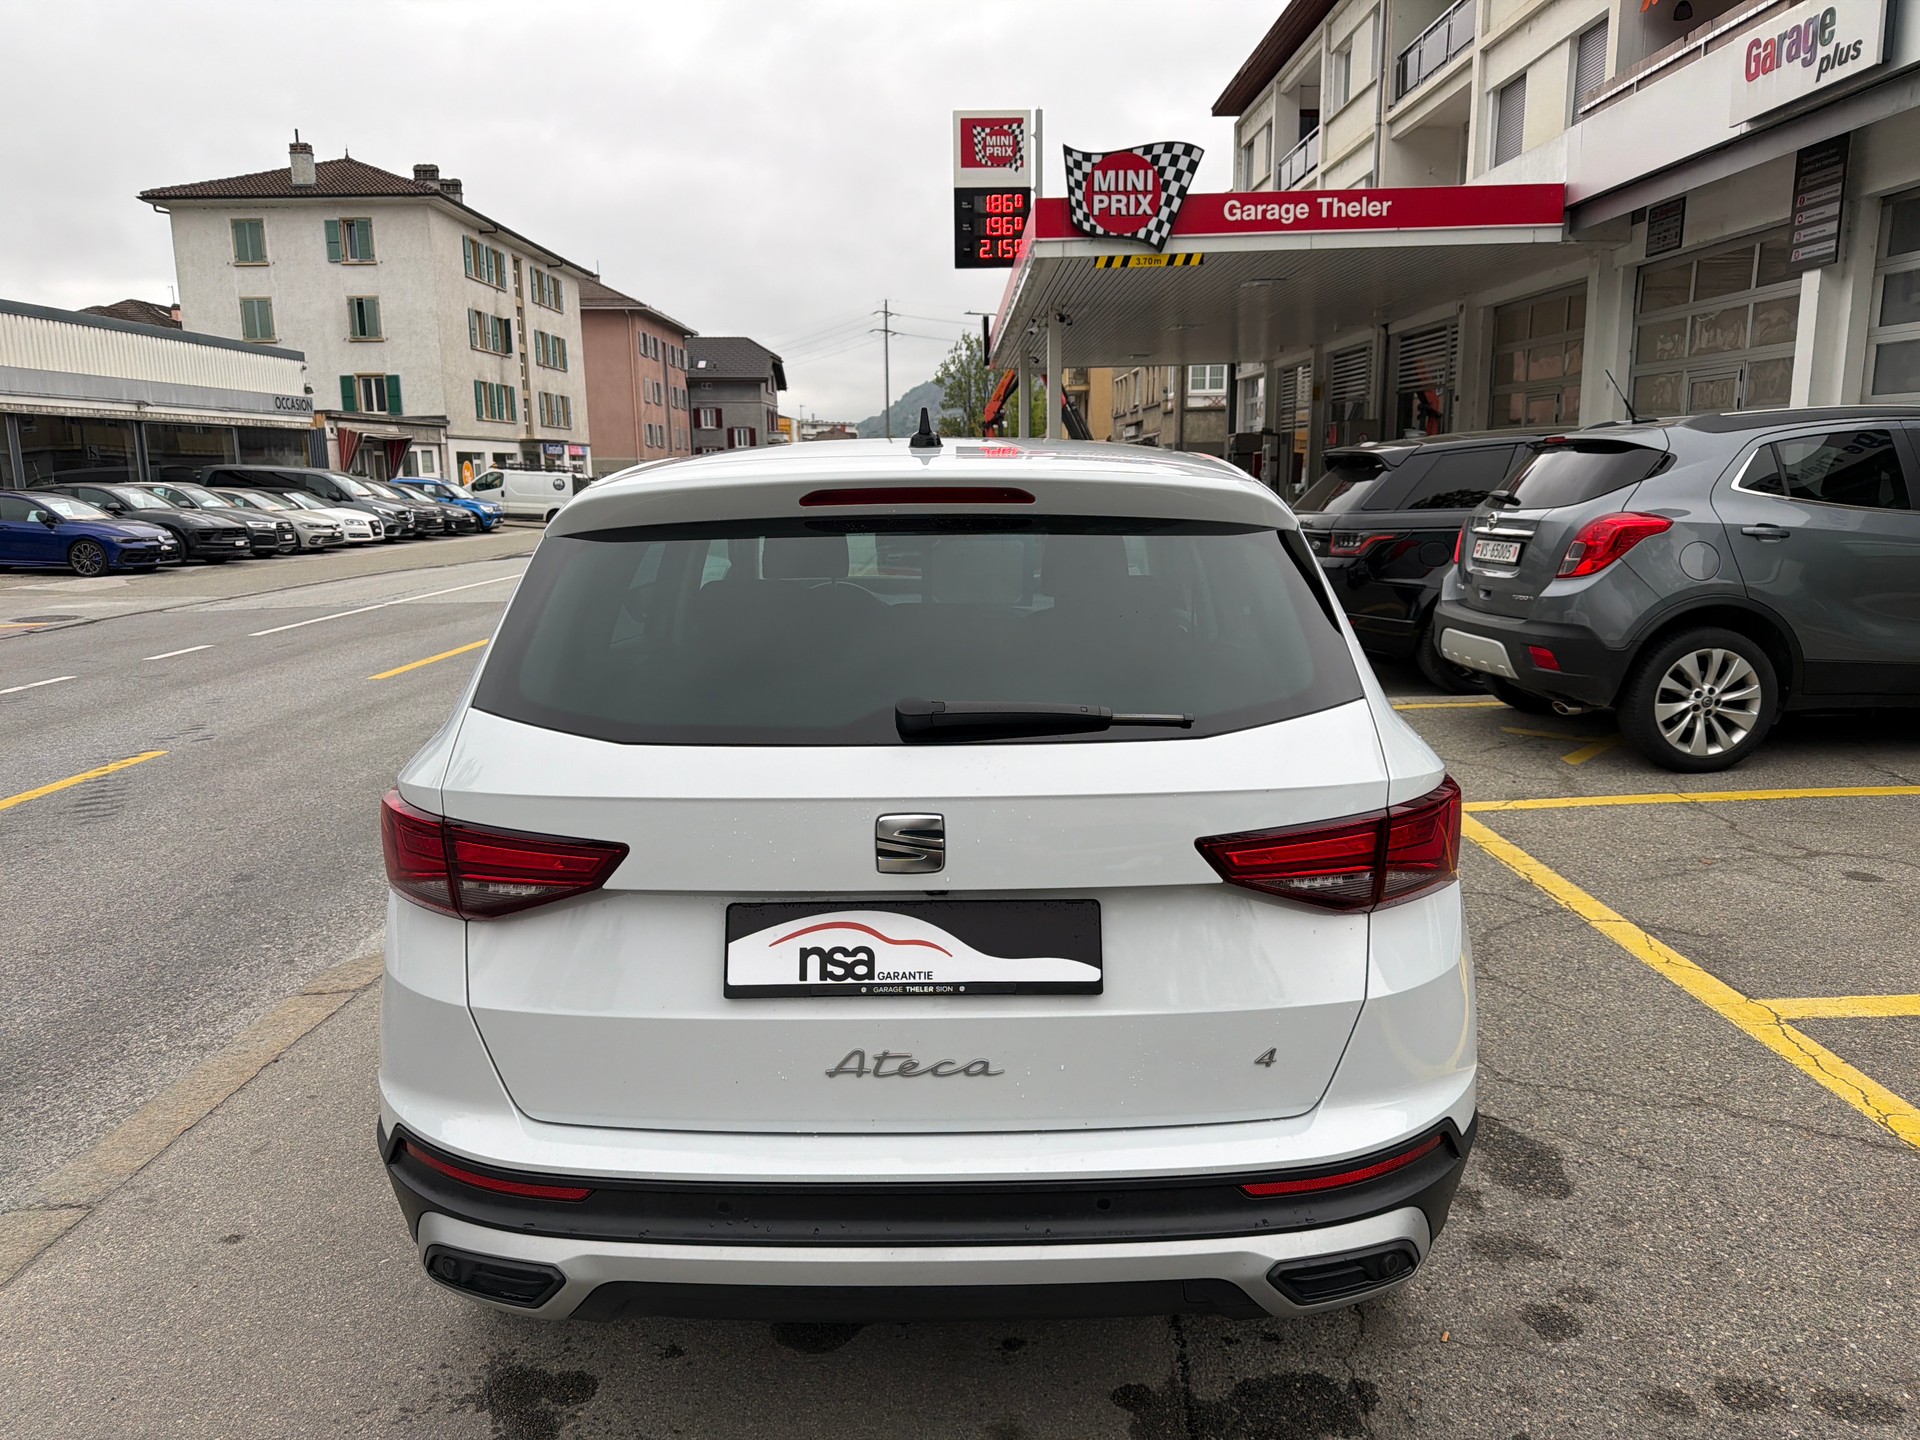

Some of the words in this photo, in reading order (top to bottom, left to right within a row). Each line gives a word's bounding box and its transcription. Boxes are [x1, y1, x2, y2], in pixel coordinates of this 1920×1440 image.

[1745, 6, 1837, 83] Garage
[1815, 38, 1863, 83] plus
[985, 134, 1014, 147] MINI
[985, 146, 1014, 159] PRIX
[1092, 169, 1154, 193] MINI
[1092, 194, 1154, 217] PRIX
[1223, 199, 1309, 223] Garage
[1317, 197, 1392, 218] Theler
[275, 396, 312, 412] OCCASION
[799, 945, 875, 982] nsa
[877, 971, 934, 981] GARANTIE
[825, 1048, 1005, 1078] Ateca
[1254, 1047, 1277, 1067] 4
